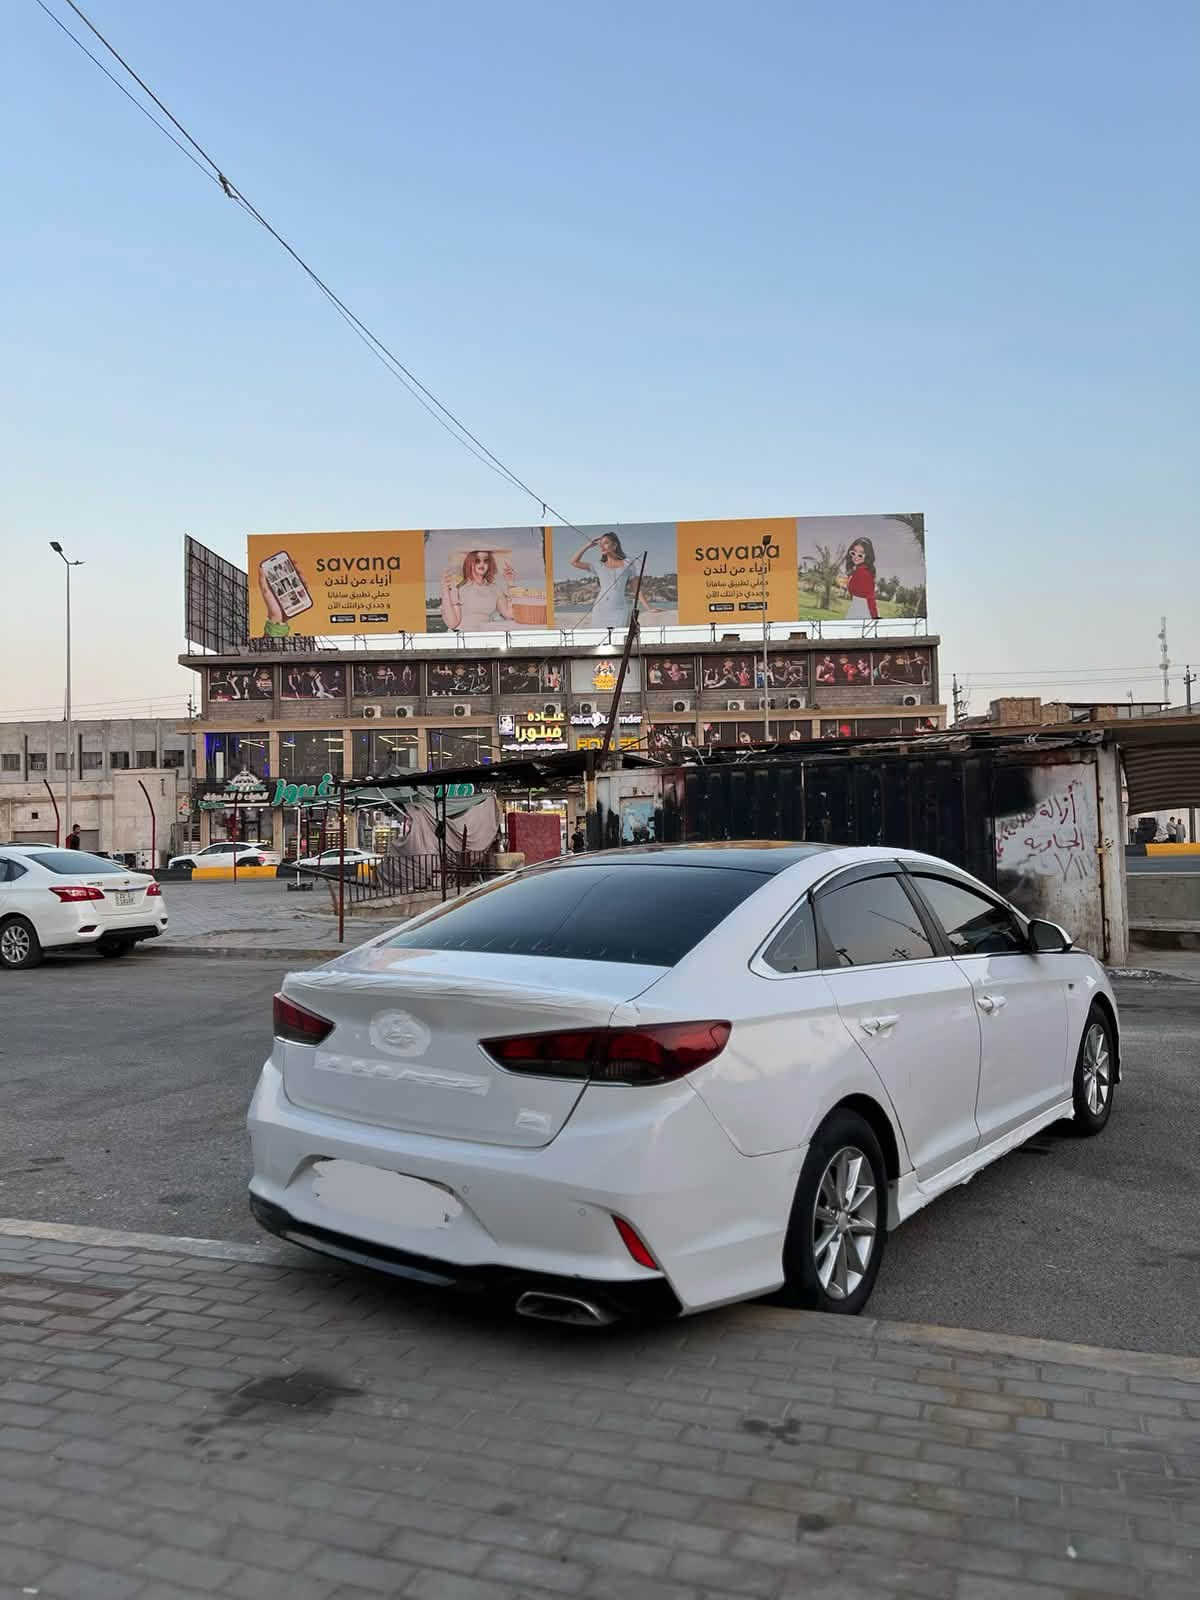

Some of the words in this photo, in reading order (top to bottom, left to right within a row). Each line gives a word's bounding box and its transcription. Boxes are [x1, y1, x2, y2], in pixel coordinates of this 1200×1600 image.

[695, 545, 780, 561] savana
[316, 556, 401, 572] savana
[703, 563, 727, 576] لندن
[729, 566, 746, 576] من
[749, 559, 771, 576] أزياء
[325, 573, 348, 587] لندن
[351, 578, 368, 588] من
[370, 571, 392, 587] أزياء
[527, 709, 565, 723] عيادة
[515, 723, 562, 743] فيلورا
